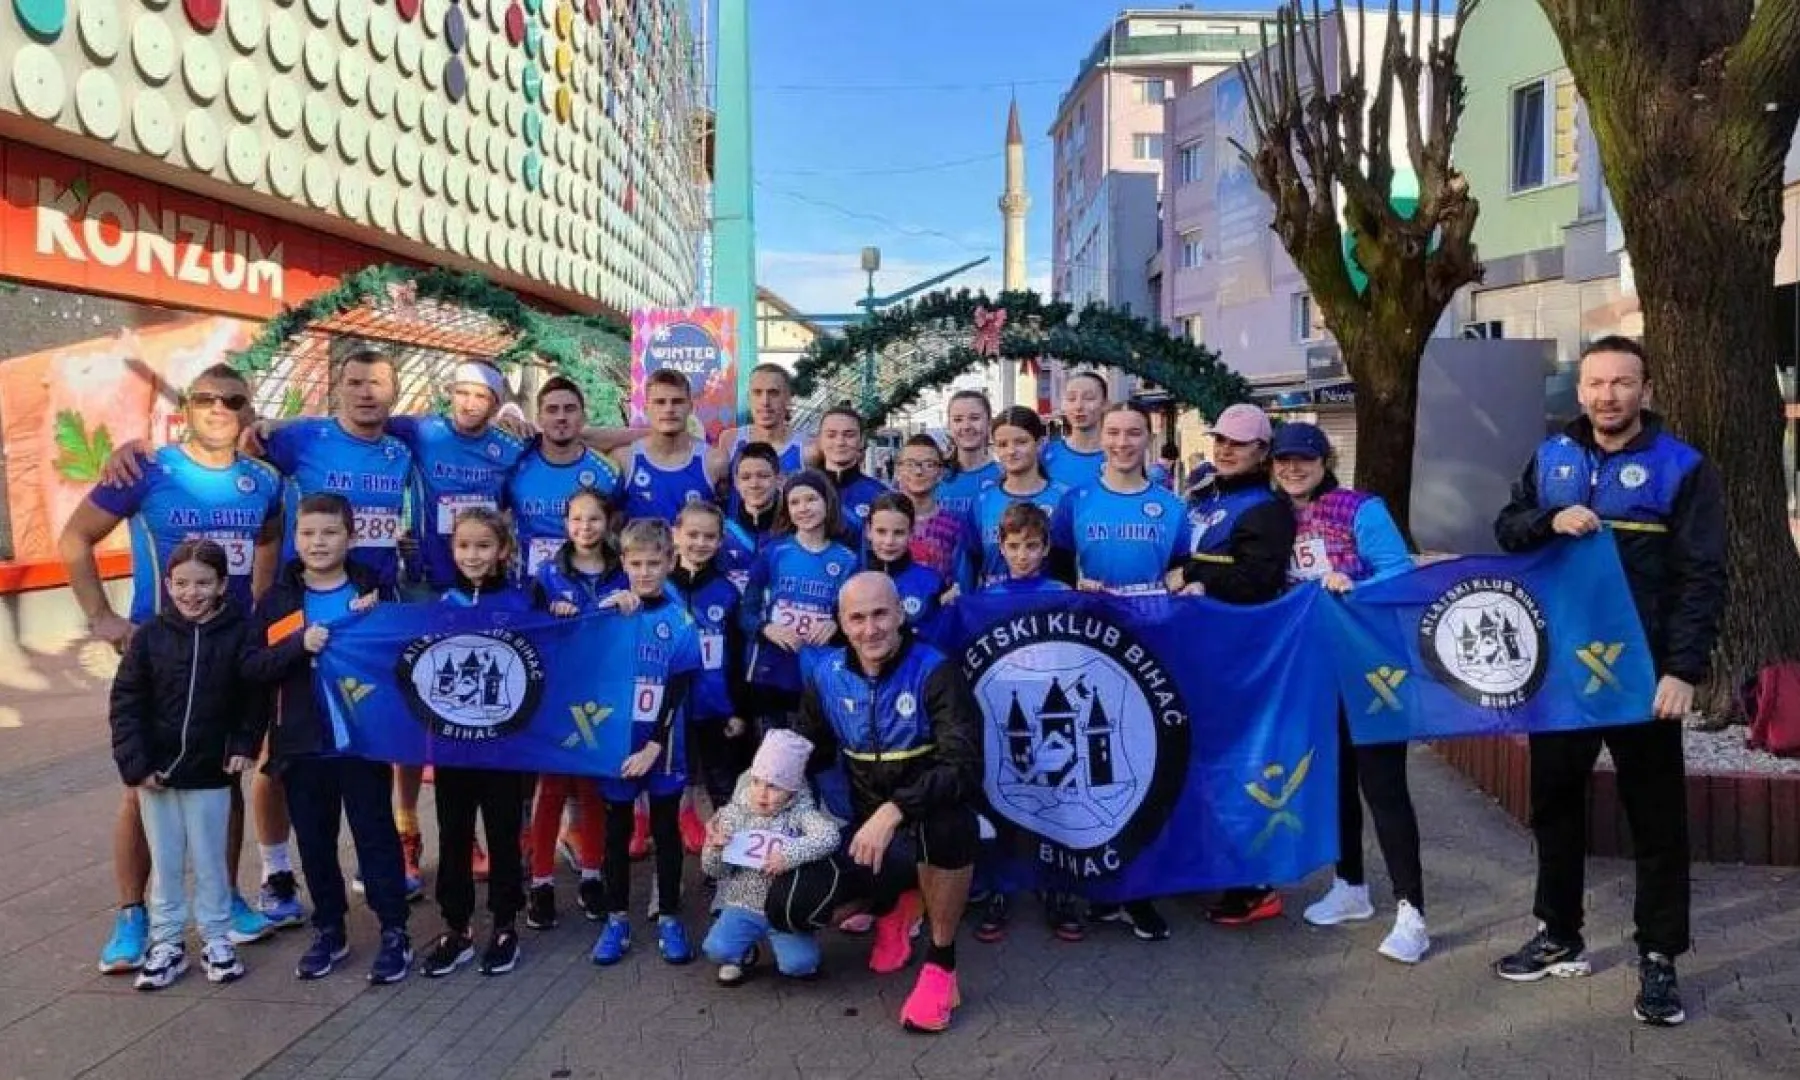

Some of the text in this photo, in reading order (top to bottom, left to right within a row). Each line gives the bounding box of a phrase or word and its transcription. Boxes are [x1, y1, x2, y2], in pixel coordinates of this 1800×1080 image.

[36, 176, 285, 300] KONZUM
[353, 517, 397, 540] 289
[1472, 579, 1513, 593] KLUB
[1047, 612, 1121, 648] KLUB
[1125, 643, 1187, 727] BIHAĆ
